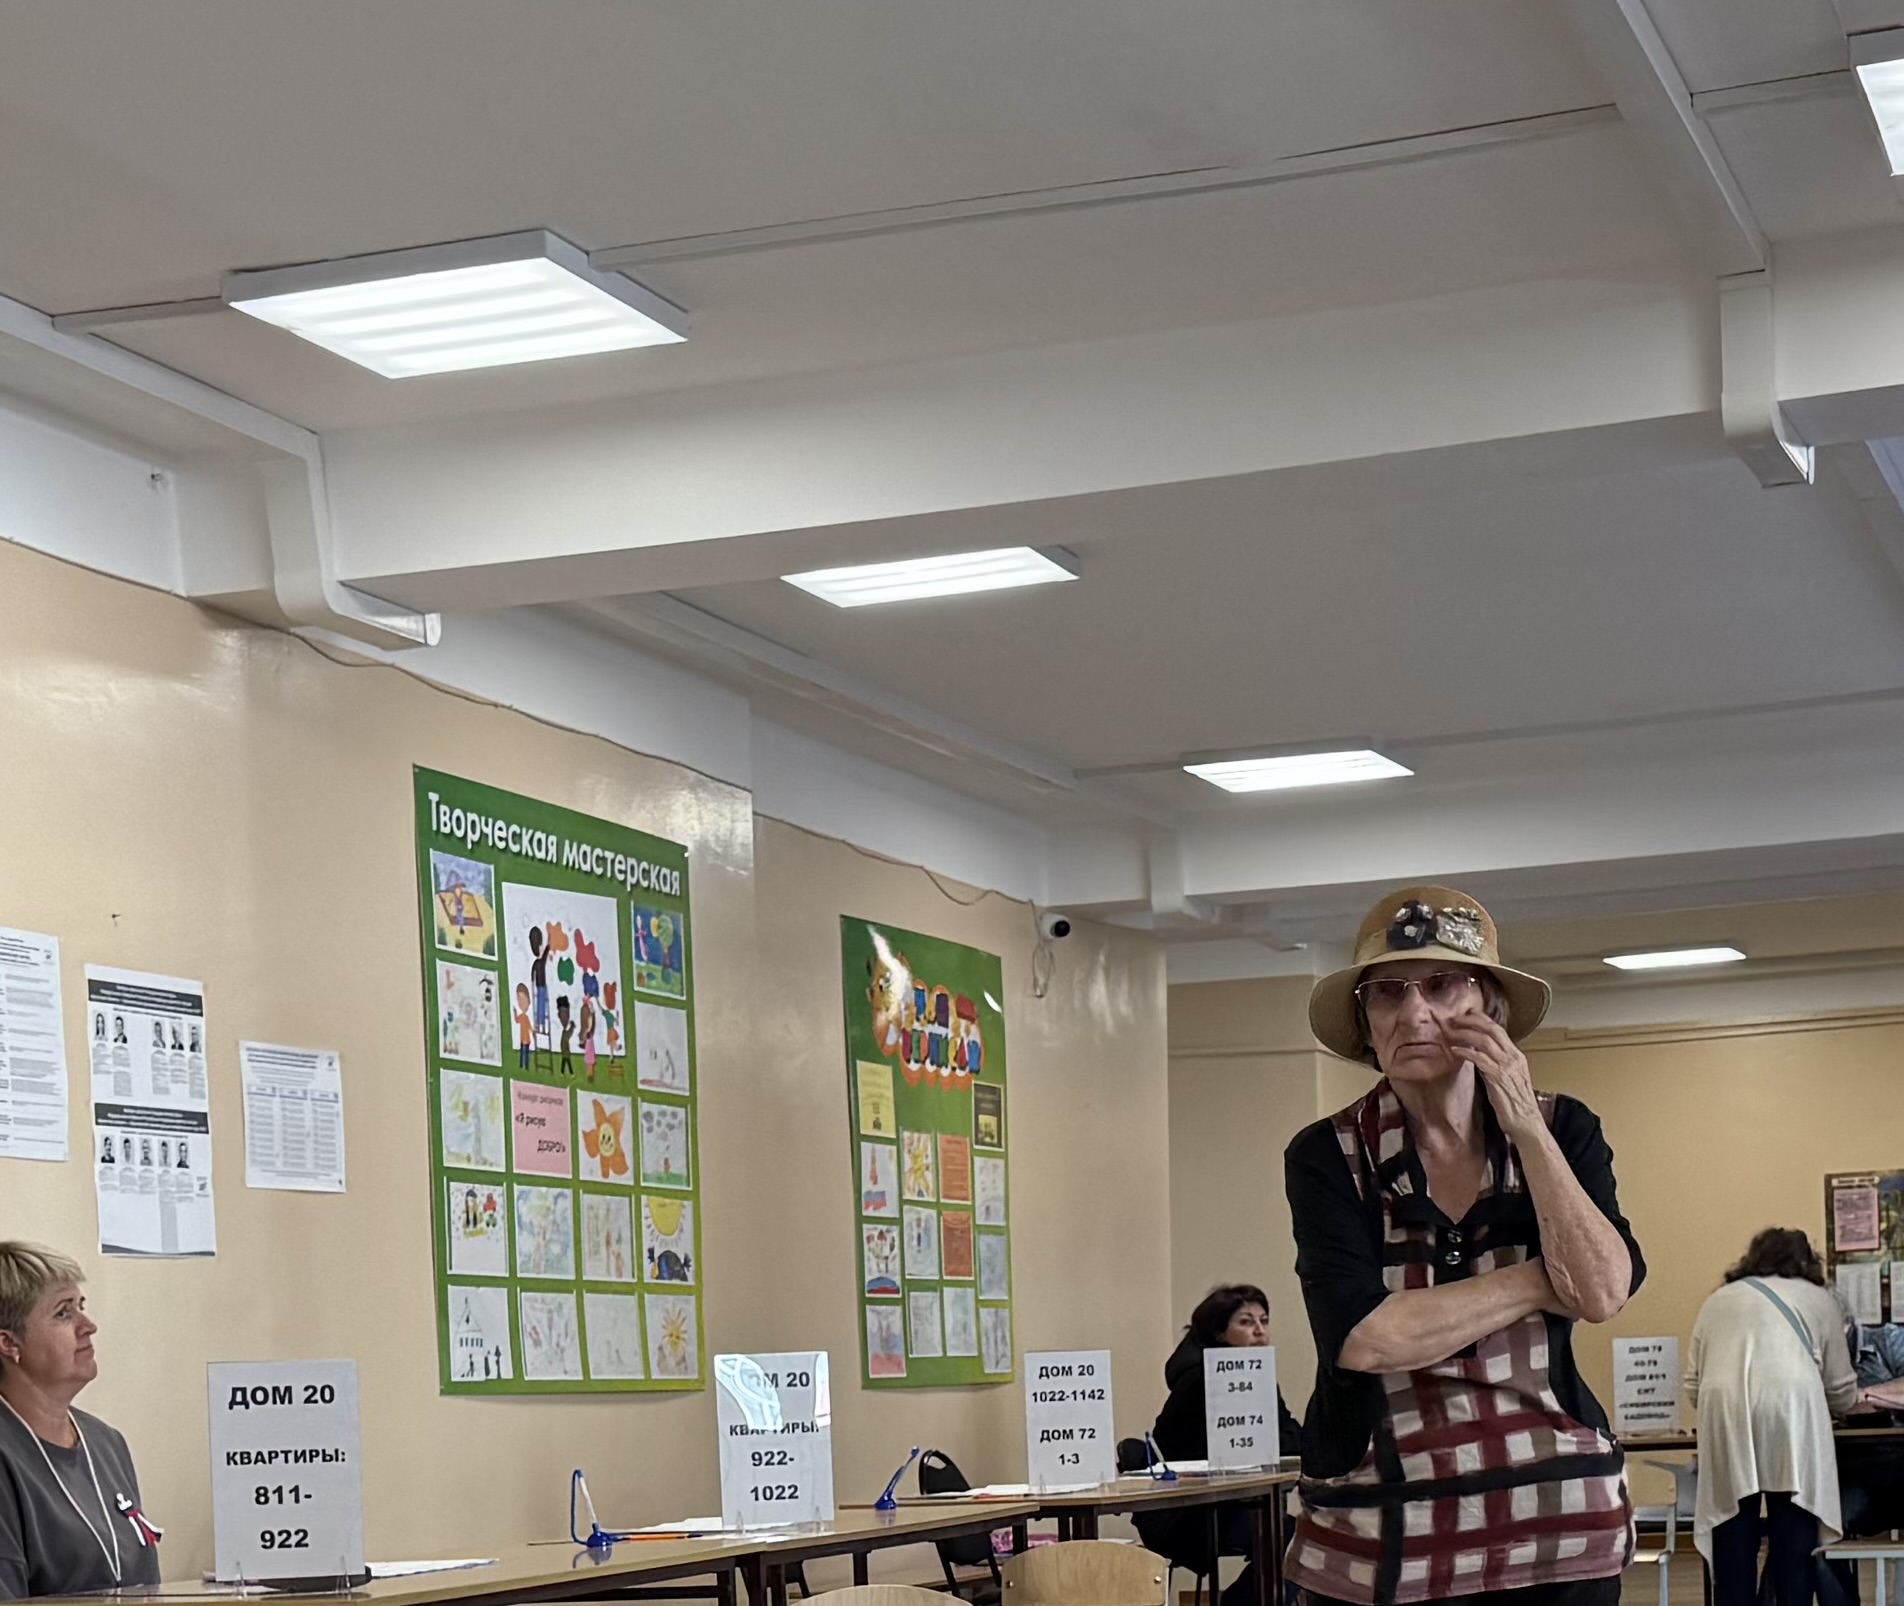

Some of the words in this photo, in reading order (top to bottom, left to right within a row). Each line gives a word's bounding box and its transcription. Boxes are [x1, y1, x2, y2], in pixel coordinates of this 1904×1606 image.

[428, 792, 558, 864] Творческая
[562, 839, 680, 896] мастерская
[1039, 1366, 1072, 1380] ДОМ
[1078, 1364, 1094, 1376] 20
[1216, 1360, 1244, 1373] ДОМ
[1248, 1359, 1262, 1370] 72
[786, 1372, 810, 1388] 20
[1228, 1382, 1253, 1392] 3-84
[228, 1386, 293, 1410] ДОМ
[303, 1384, 335, 1404] 20
[1032, 1388, 1105, 1402] 1022-1142
[1217, 1416, 1245, 1428] ДОМ
[1249, 1414, 1263, 1426] 74
[1040, 1428, 1074, 1443] ДОМ
[1078, 1428, 1096, 1439] 72
[1229, 1437, 1254, 1448] 1-35
[226, 1448, 346, 1466] КВАРТИРЫ:
[751, 1450, 794, 1466] 922-
[1058, 1452, 1080, 1465] 1-3
[254, 1484, 312, 1505] 811-
[750, 1484, 799, 1502] 1022
[260, 1528, 309, 1550] 922
